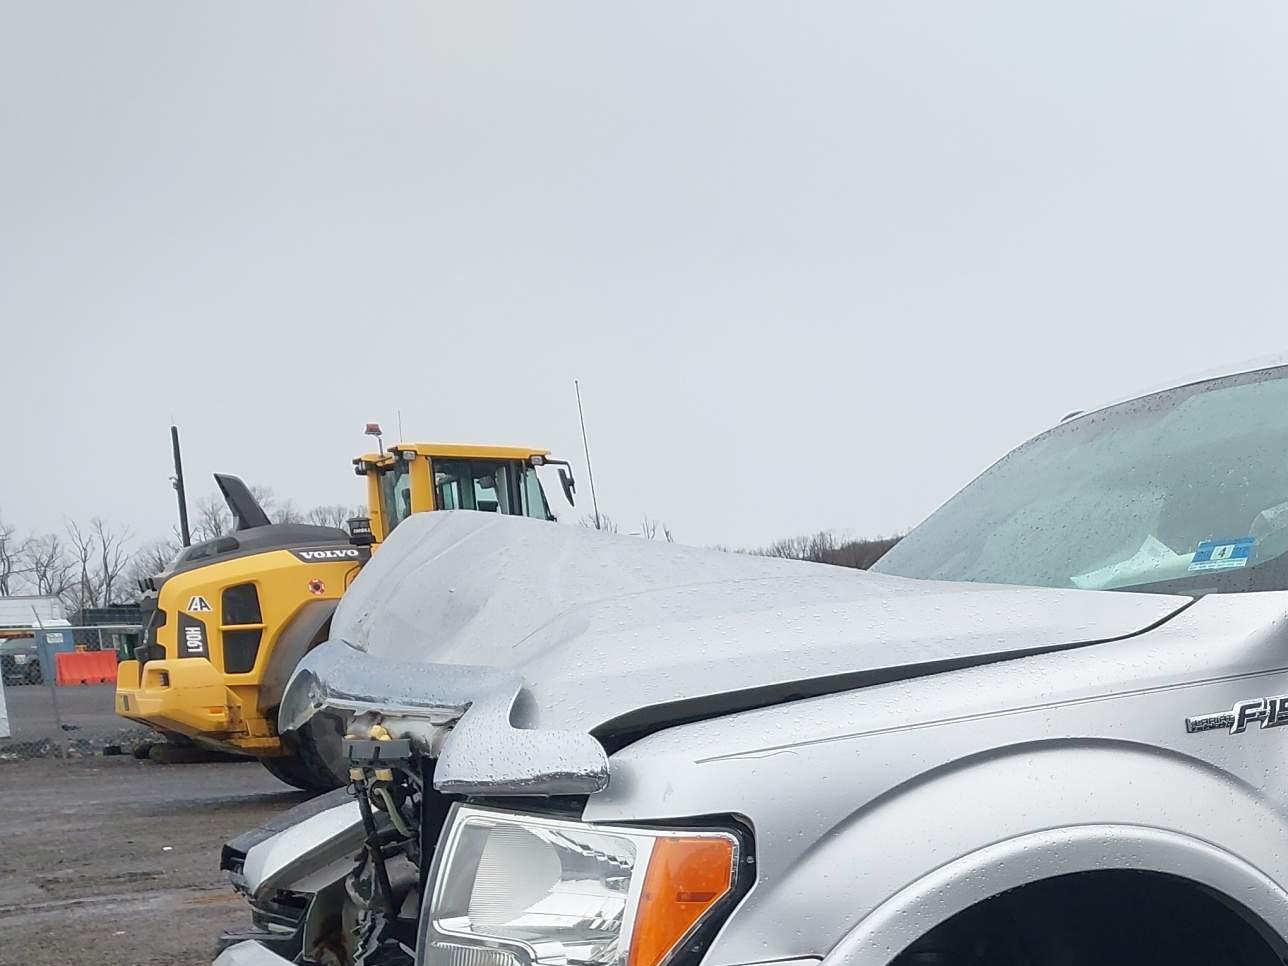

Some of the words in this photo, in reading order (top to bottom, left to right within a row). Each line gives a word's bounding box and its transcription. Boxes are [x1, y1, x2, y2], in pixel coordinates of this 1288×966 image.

[299, 549, 359, 559] VOLVO
[1217, 547, 1227, 558] 4
[184, 626, 204, 653] L90H
